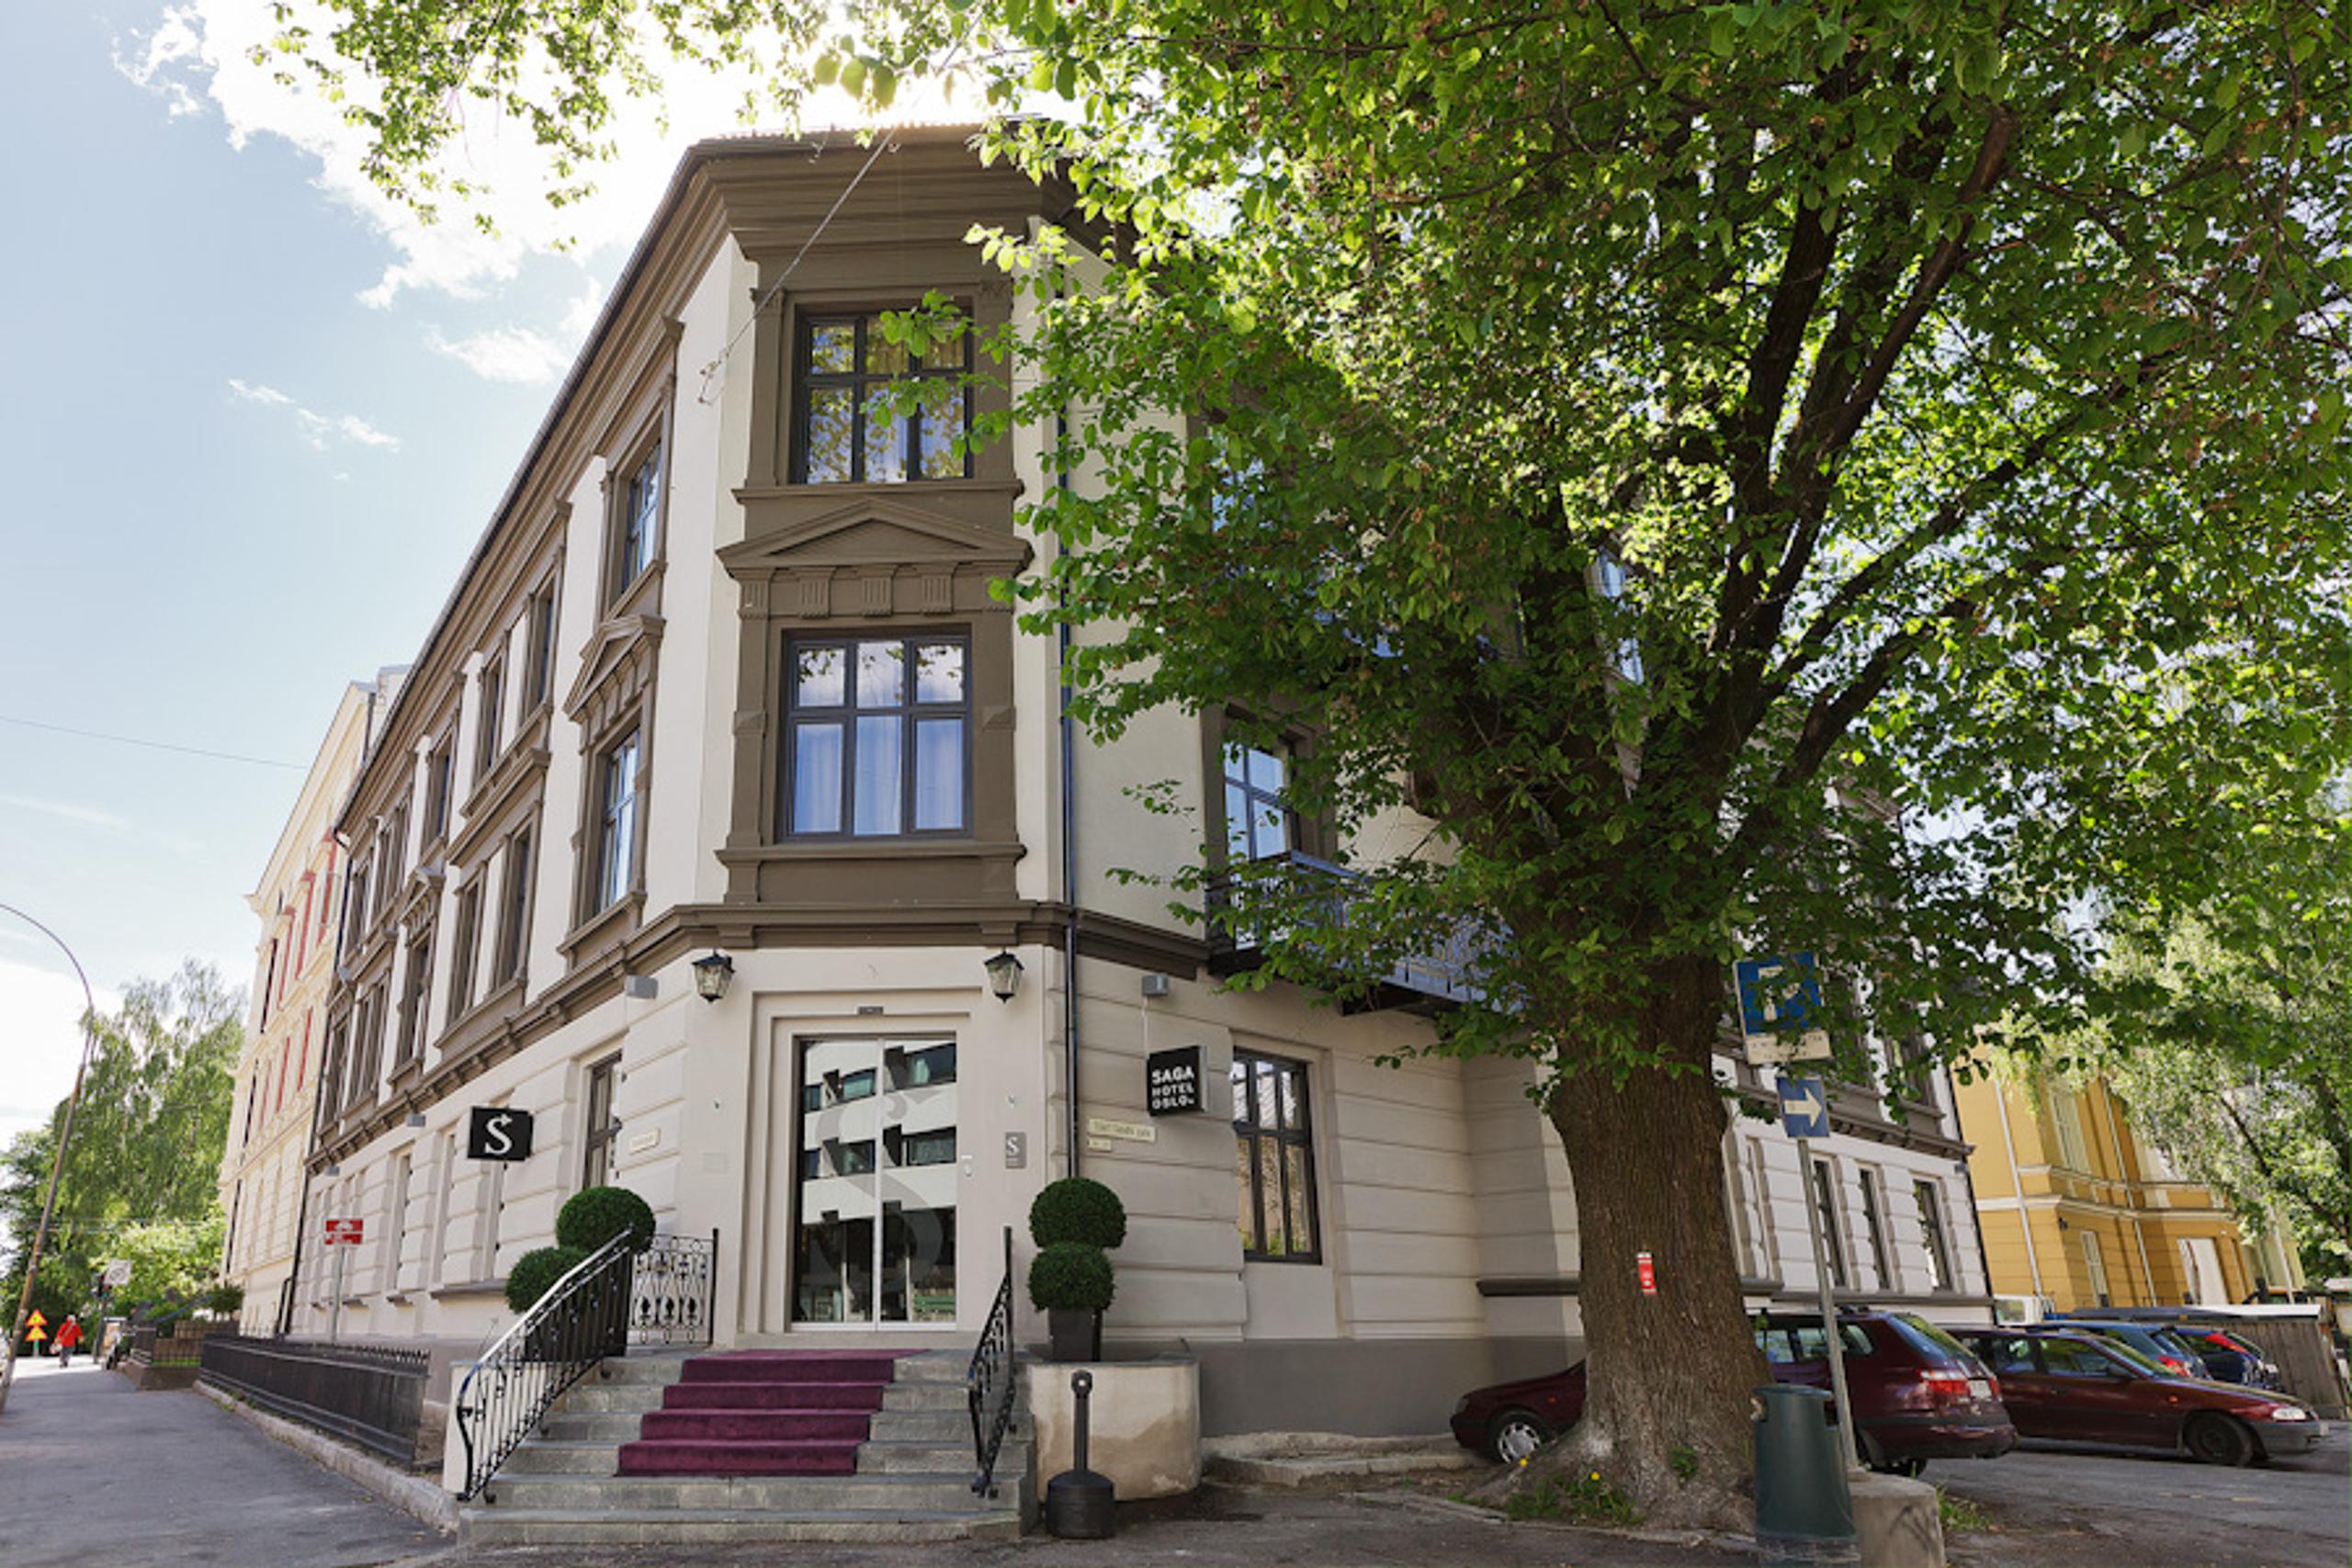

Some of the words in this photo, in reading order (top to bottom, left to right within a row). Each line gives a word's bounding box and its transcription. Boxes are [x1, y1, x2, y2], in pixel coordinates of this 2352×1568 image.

[1151, 1066, 1194, 1085] SAGA
[1151, 1083, 1194, 1098] HOTEL
[484, 1113, 513, 1155] S
[1007, 1136, 1020, 1156] S
